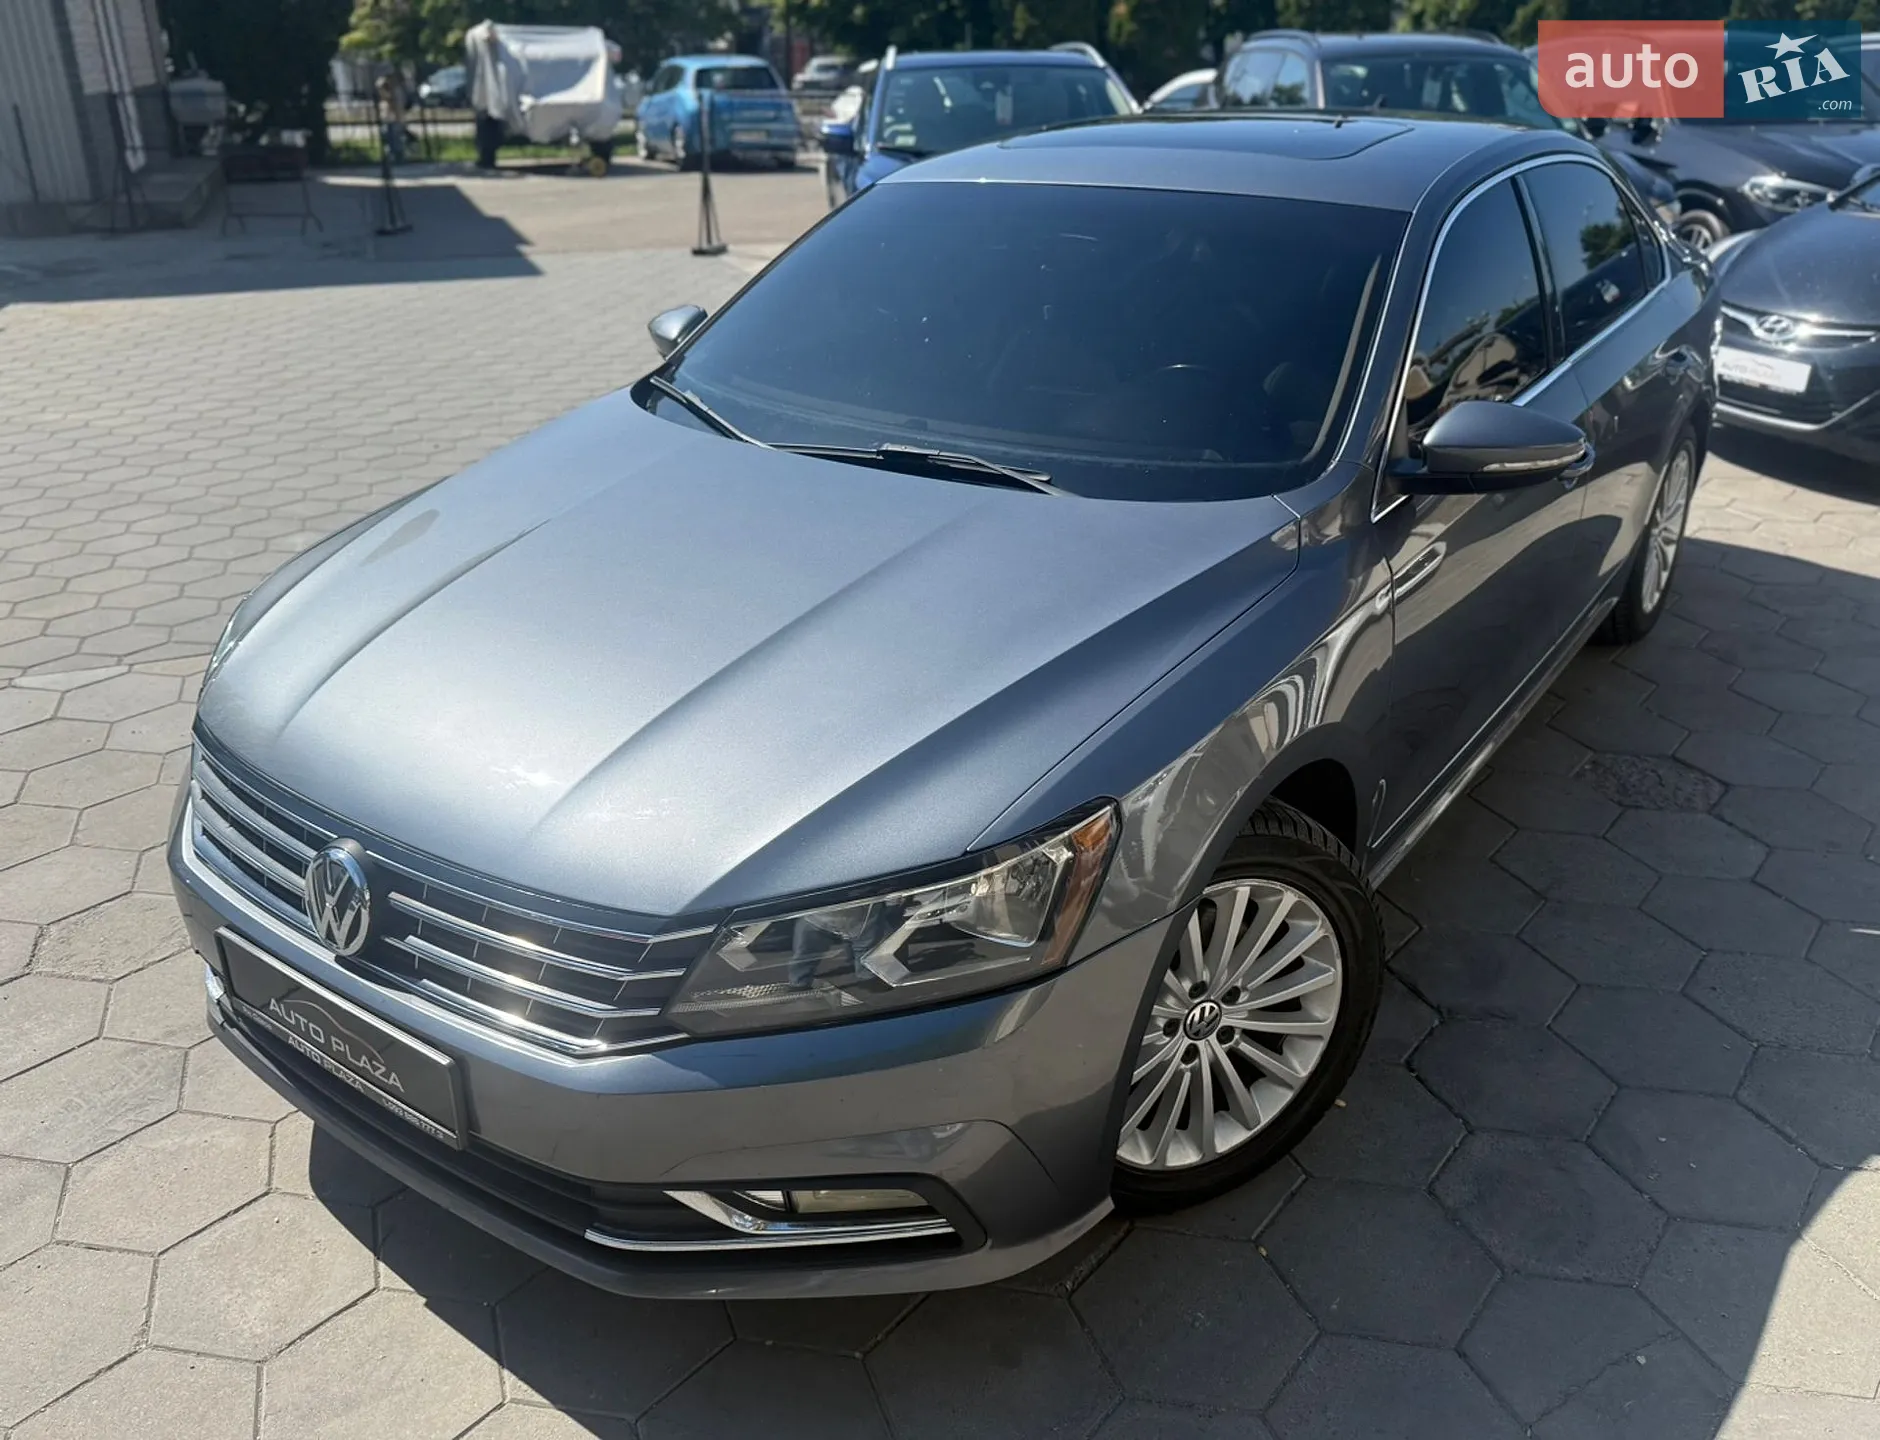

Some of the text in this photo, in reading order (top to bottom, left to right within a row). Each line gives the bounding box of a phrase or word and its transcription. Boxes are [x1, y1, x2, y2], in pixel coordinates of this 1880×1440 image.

[268, 997, 325, 1044] AUTO
[331, 1035, 405, 1093] PLAZA
[288, 1036, 321, 1065] AUTO
